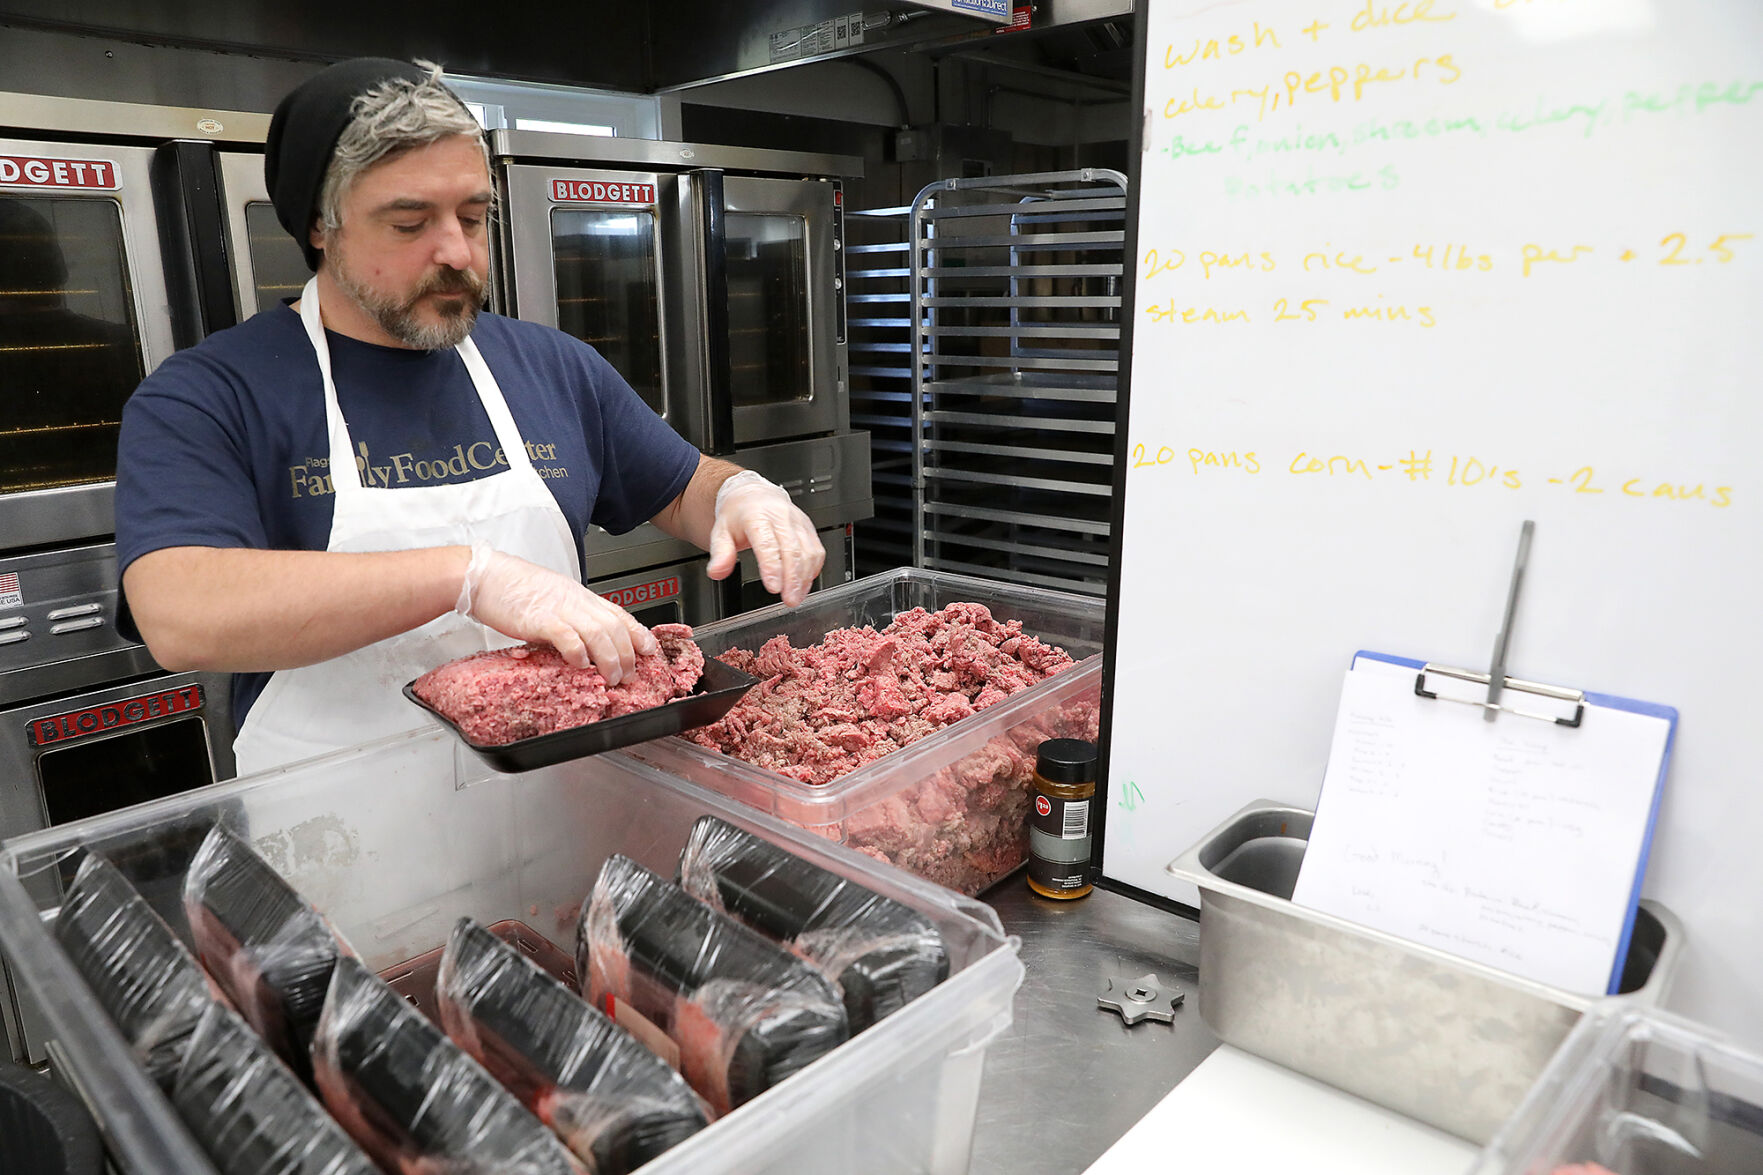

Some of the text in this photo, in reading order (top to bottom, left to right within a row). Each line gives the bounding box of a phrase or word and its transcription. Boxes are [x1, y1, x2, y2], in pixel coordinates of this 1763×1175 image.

[1163, 20, 1283, 70] wash
[1350, 0, 1457, 32] dice
[556, 182, 650, 202] BLODGETT
[1145, 248, 1186, 280] 20
[1199, 250, 1276, 280] pans
[1303, 242, 1377, 275] rice
[1521, 242, 1594, 278] per
[1145, 294, 1437, 328] steam 25 mins
[1133, 443, 1175, 468] 20
[1187, 448, 1261, 475] pans
[40, 689, 193, 742] BLODGETT
